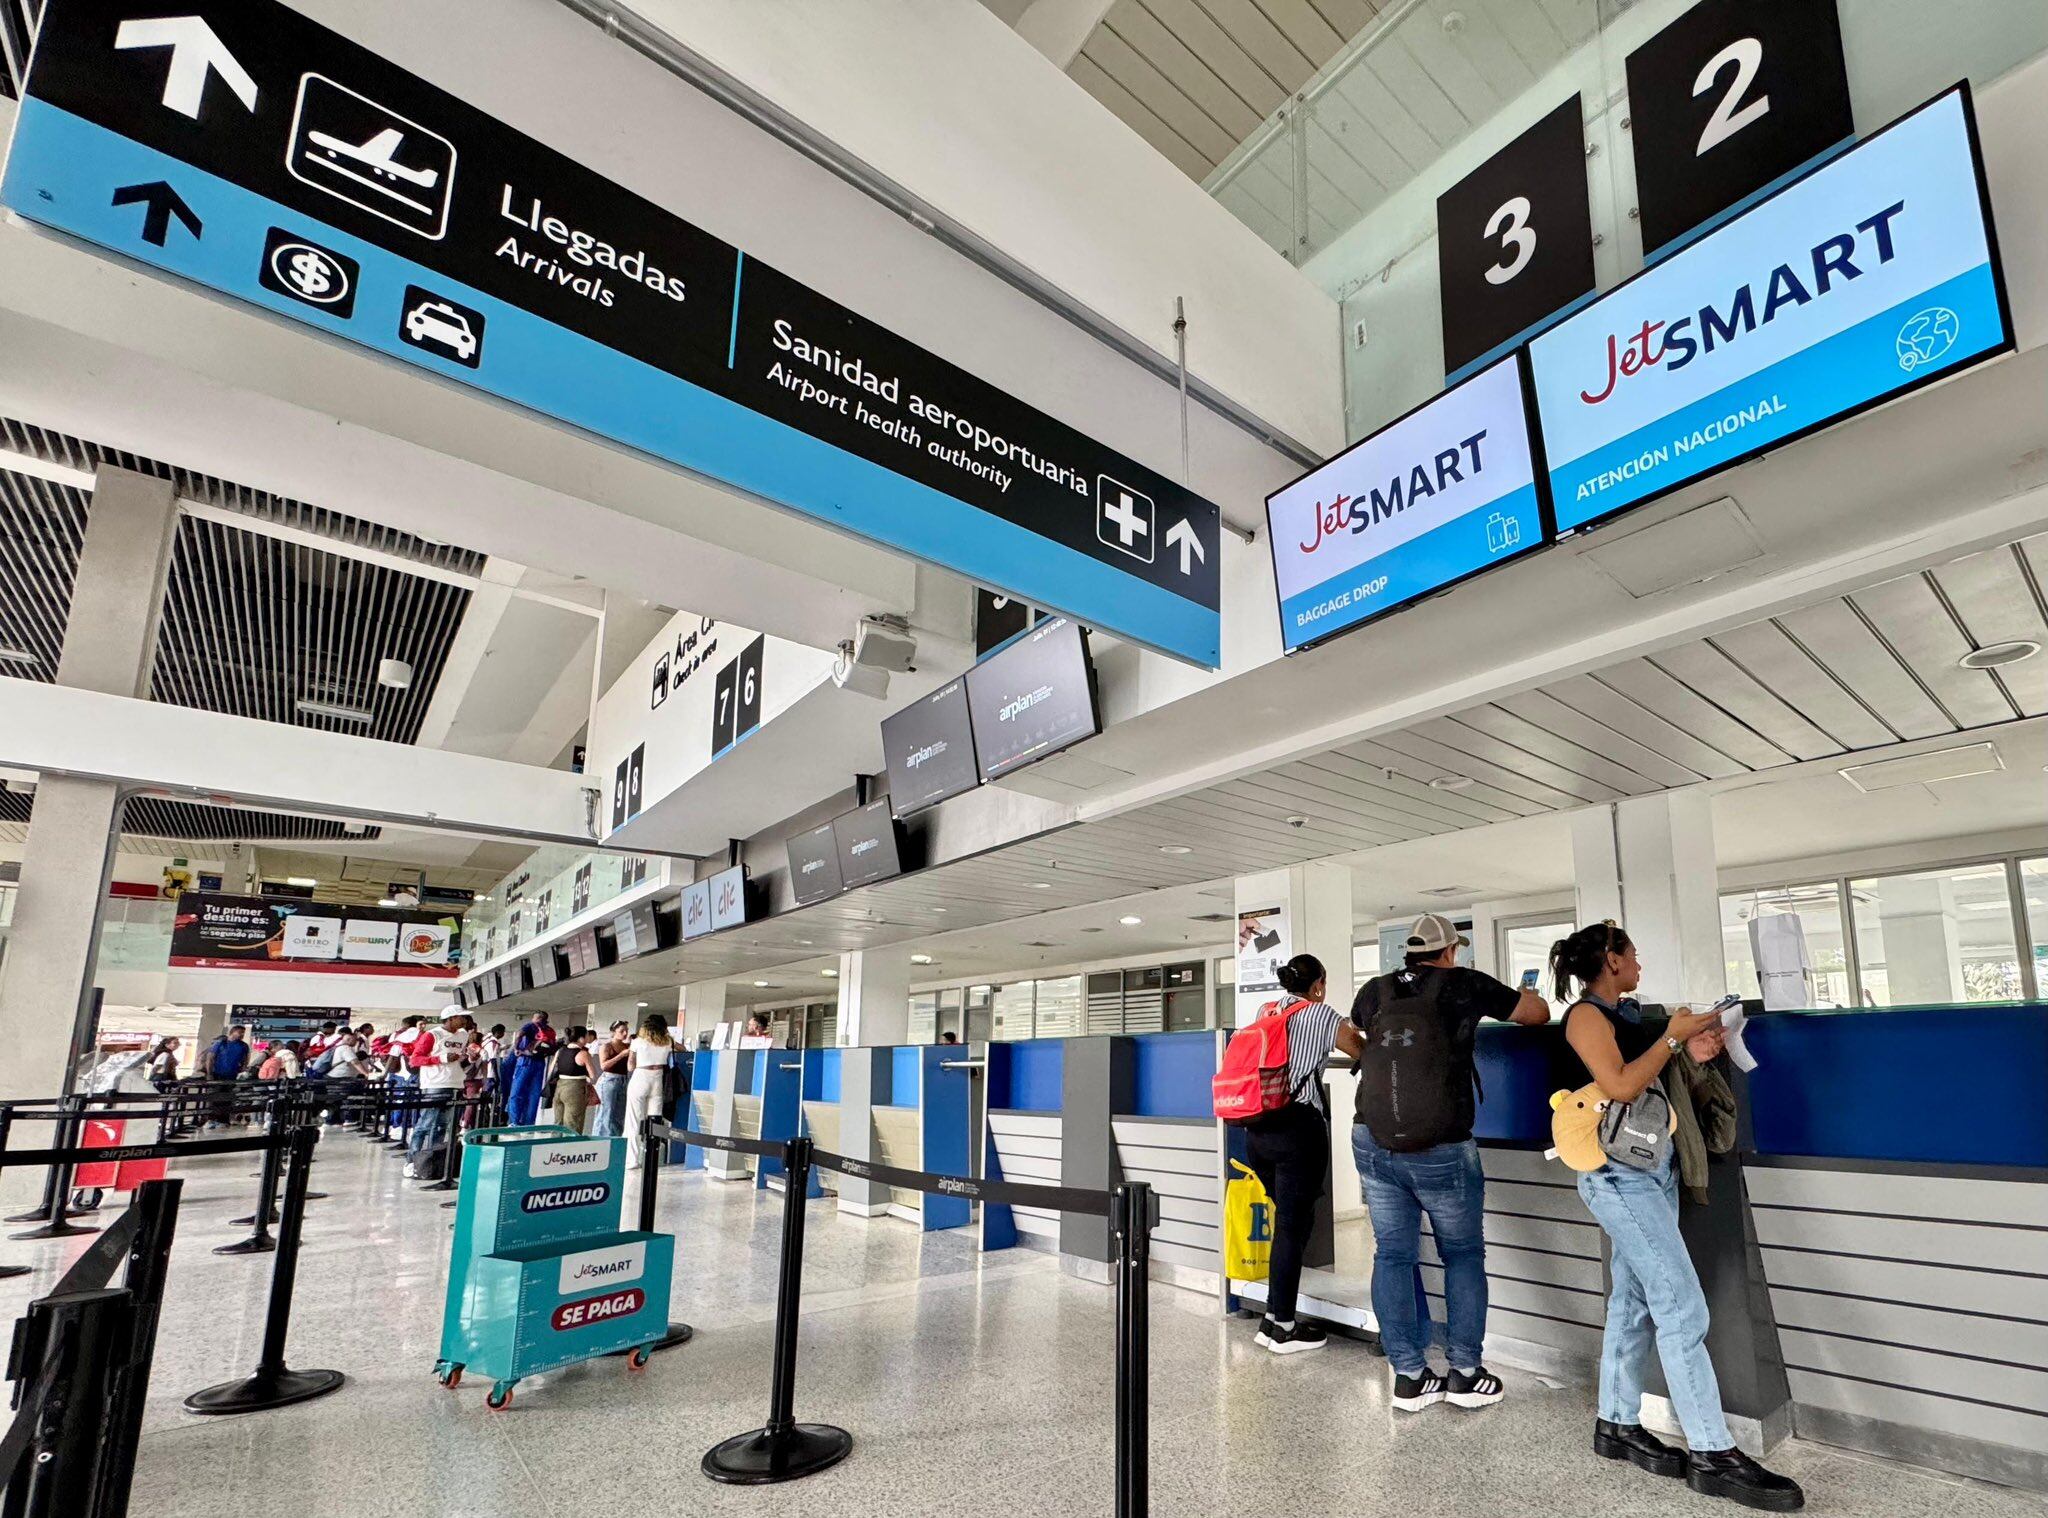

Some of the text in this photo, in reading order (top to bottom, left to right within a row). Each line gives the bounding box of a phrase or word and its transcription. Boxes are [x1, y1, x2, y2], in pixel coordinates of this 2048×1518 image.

[1692, 36, 1771, 157] 2
[502, 183, 686, 303] Llegadas
[1482, 196, 1537, 287] 3
[495, 236, 614, 308] Arrivals
[1580, 198, 1905, 405] JetSMART
[772, 319, 1089, 496] Sanidad aeroportuaria
[766, 362, 1013, 493] Airport health authority
[1576, 394, 1787, 501] ATENCIÓN NACIONAL
[1299, 428, 1488, 554] JetSMART
[1297, 576, 1389, 627] BAGGAGE DROP
[674, 631, 697, 665] Área
[744, 667, 755, 705] 6
[720, 687, 730, 725] 7
[999, 693, 1033, 721] airplan
[906, 745, 932, 768] airplan
[616, 780, 624, 809] 9
[631, 766, 639, 796] 8
[205, 904, 262, 917] Tu primer
[688, 893, 703, 926] clic
[717, 880, 735, 918] clic
[203, 913, 269, 925] destino es:
[210, 930, 247, 939] segundo
[248, 932, 266, 940] piso
[346, 935, 394, 946] SUBWAY
[99, 1147, 153, 1160] airplan
[543, 1152, 599, 1166] JetSMART
[841, 1157, 861, 1174] airplan
[526, 1187, 605, 1210] INCLUIDO
[938, 1176, 965, 1193] airplan
[574, 1259, 633, 1279] JetSMART
[560, 1293, 636, 1326] SE PAGA
